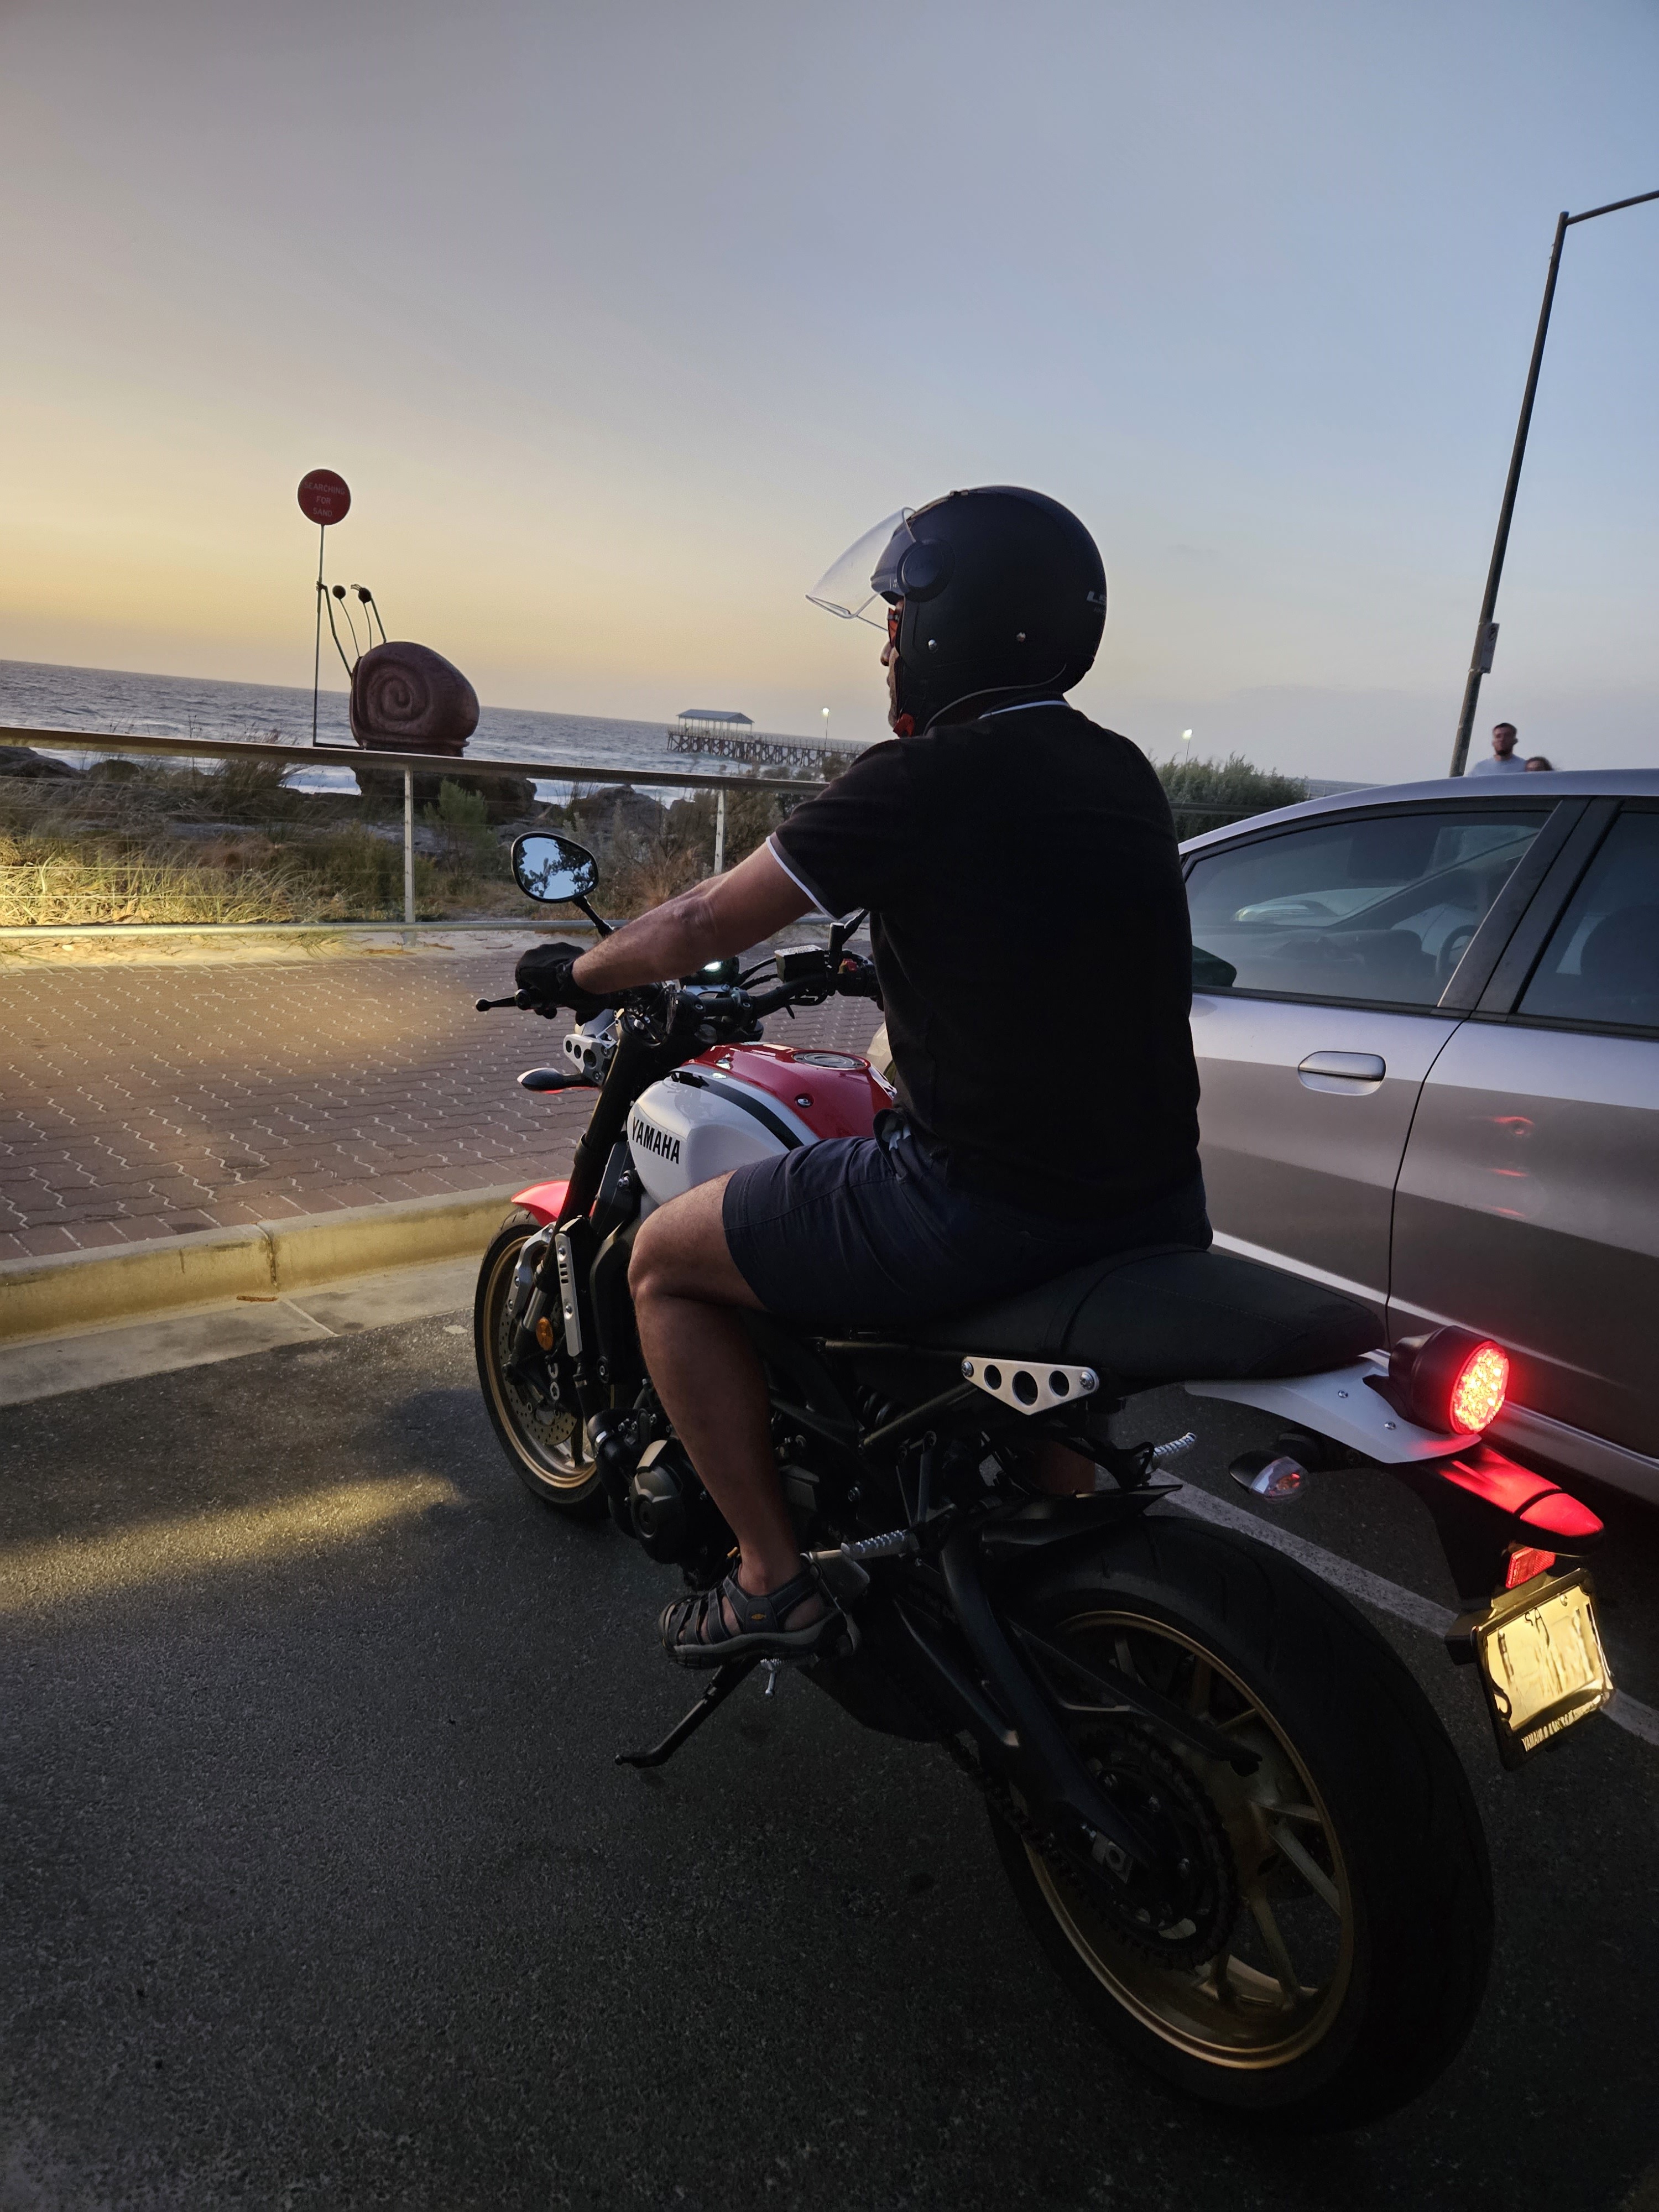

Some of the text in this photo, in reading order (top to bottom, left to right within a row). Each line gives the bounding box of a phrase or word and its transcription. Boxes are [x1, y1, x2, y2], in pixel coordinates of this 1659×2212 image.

[304, 481, 345, 495] SEARCHING
[316, 495, 331, 504] FOR
[313, 507, 332, 517] SAND
[632, 1117, 680, 1164] YAMAHA
